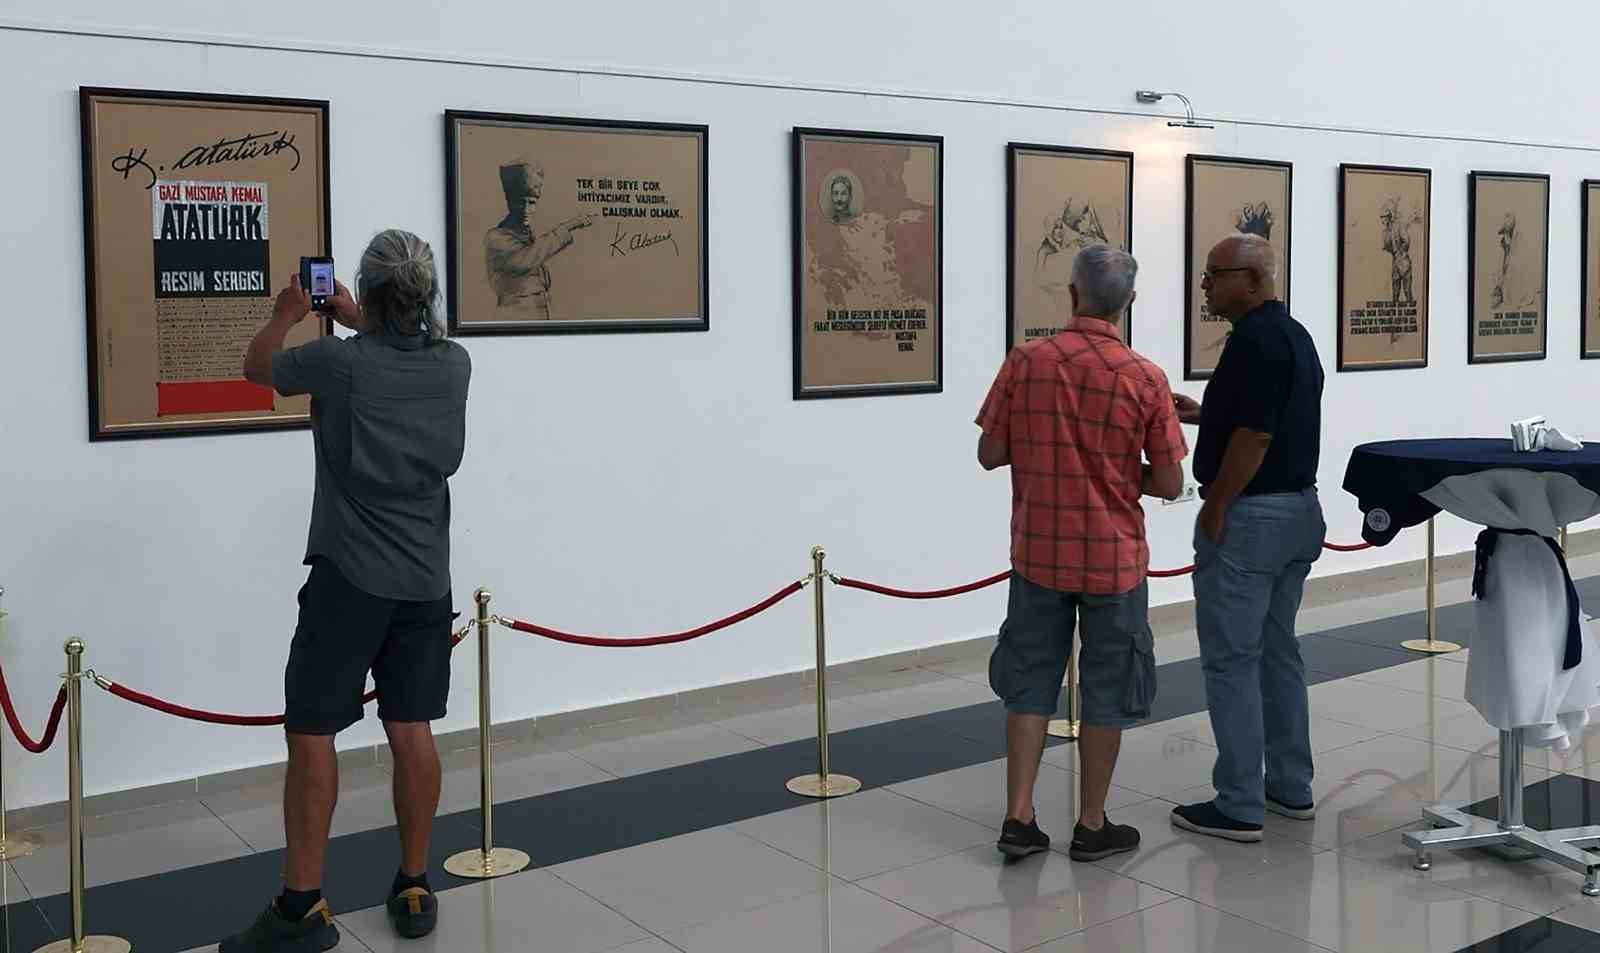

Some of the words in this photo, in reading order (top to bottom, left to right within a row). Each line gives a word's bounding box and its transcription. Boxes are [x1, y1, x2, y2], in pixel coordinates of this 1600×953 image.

[576, 178, 594, 190] TEK
[185, 186, 227, 202] MUSTAFA
[231, 187, 263, 203] KEMAL
[602, 206, 646, 218] ÇALIŞKAN
[650, 208, 684, 220] OLMAK.
[161, 203, 263, 241] ATATÜRK
